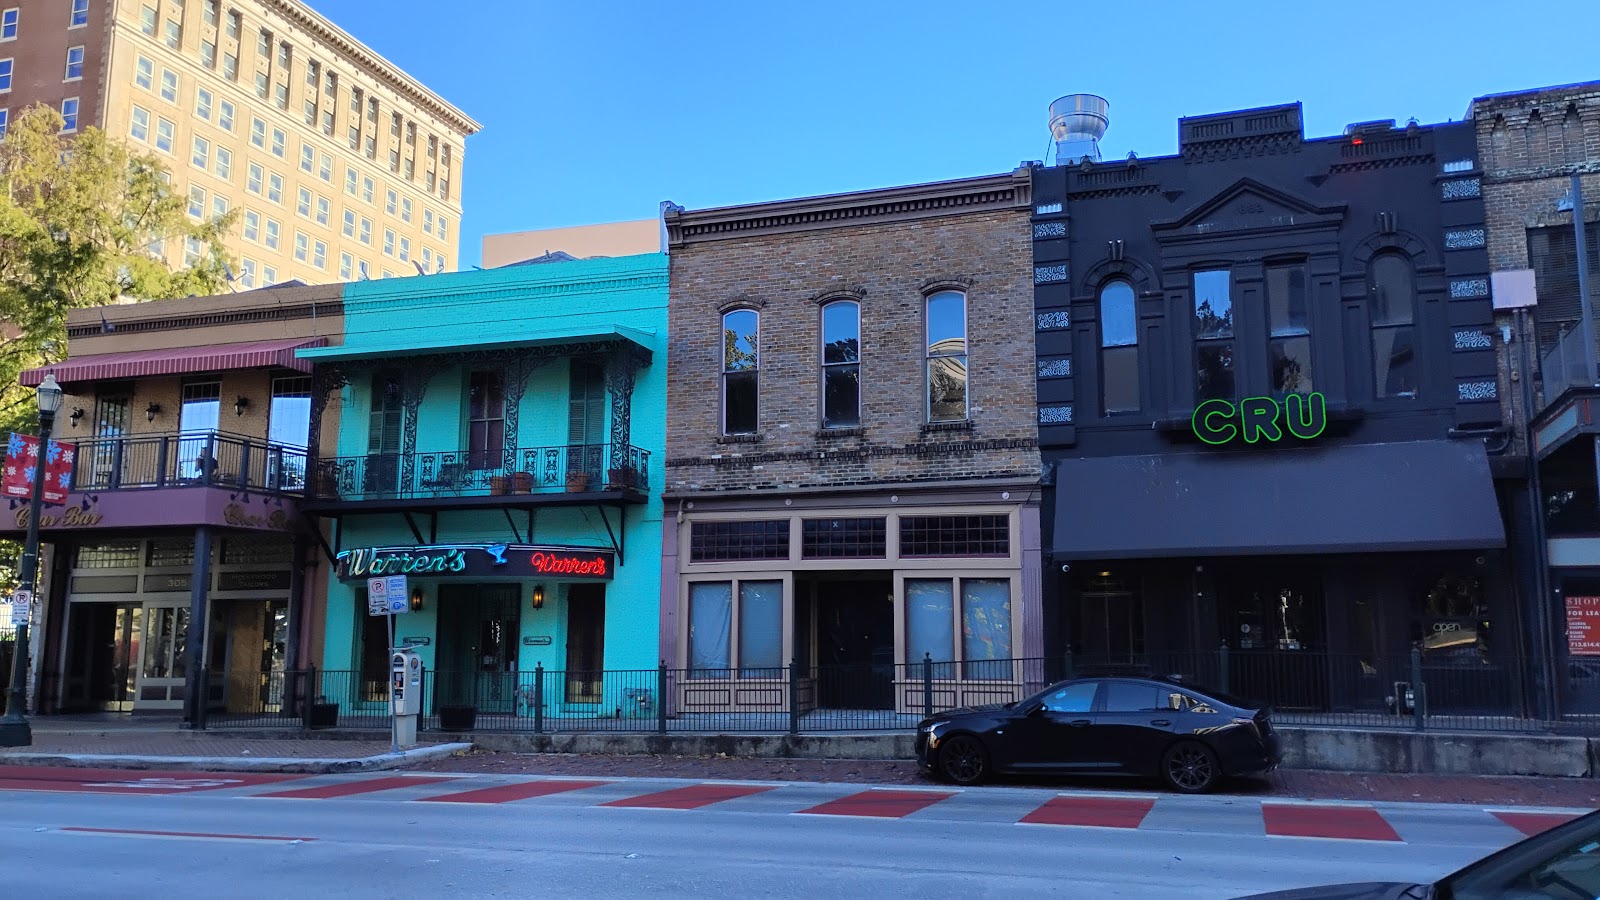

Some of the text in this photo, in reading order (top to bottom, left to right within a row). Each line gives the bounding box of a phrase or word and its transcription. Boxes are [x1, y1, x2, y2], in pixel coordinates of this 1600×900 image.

[1235, 202, 1264, 215] 892
[1191, 391, 1327, 445] CRU
[15, 506, 103, 528] Car Bar
[347, 547, 466, 576] Warren's
[531, 552, 606, 575] Warren's
[1433, 623, 1461, 637] open
